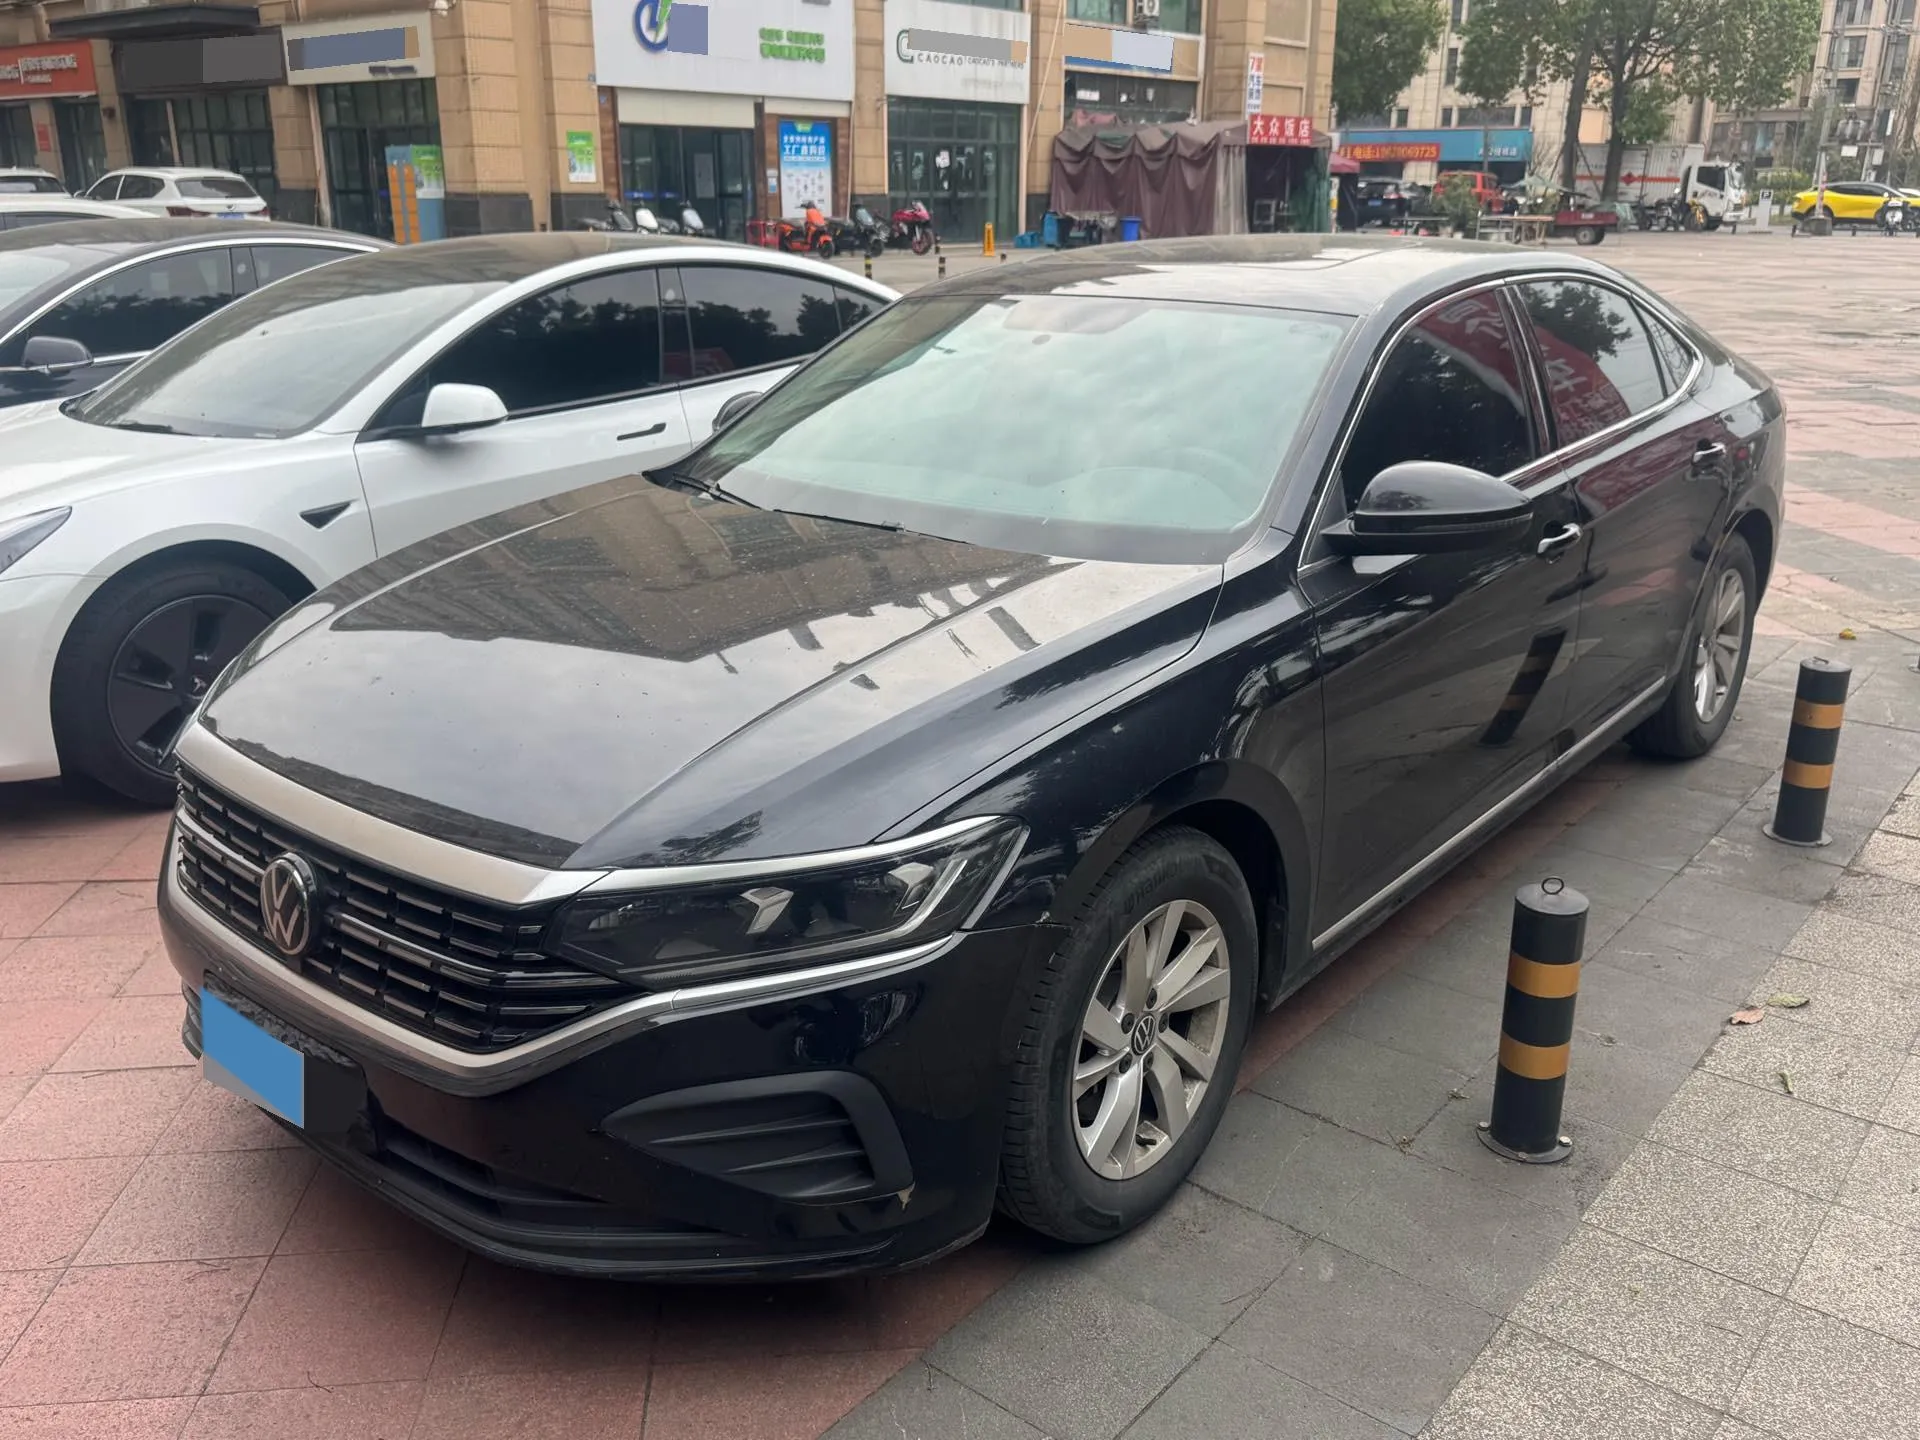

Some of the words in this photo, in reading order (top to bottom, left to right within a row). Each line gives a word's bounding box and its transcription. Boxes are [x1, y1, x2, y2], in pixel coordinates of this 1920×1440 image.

[917, 52, 963, 66] CAOCAO
[1252, 116, 1311, 137] 大众饭店
